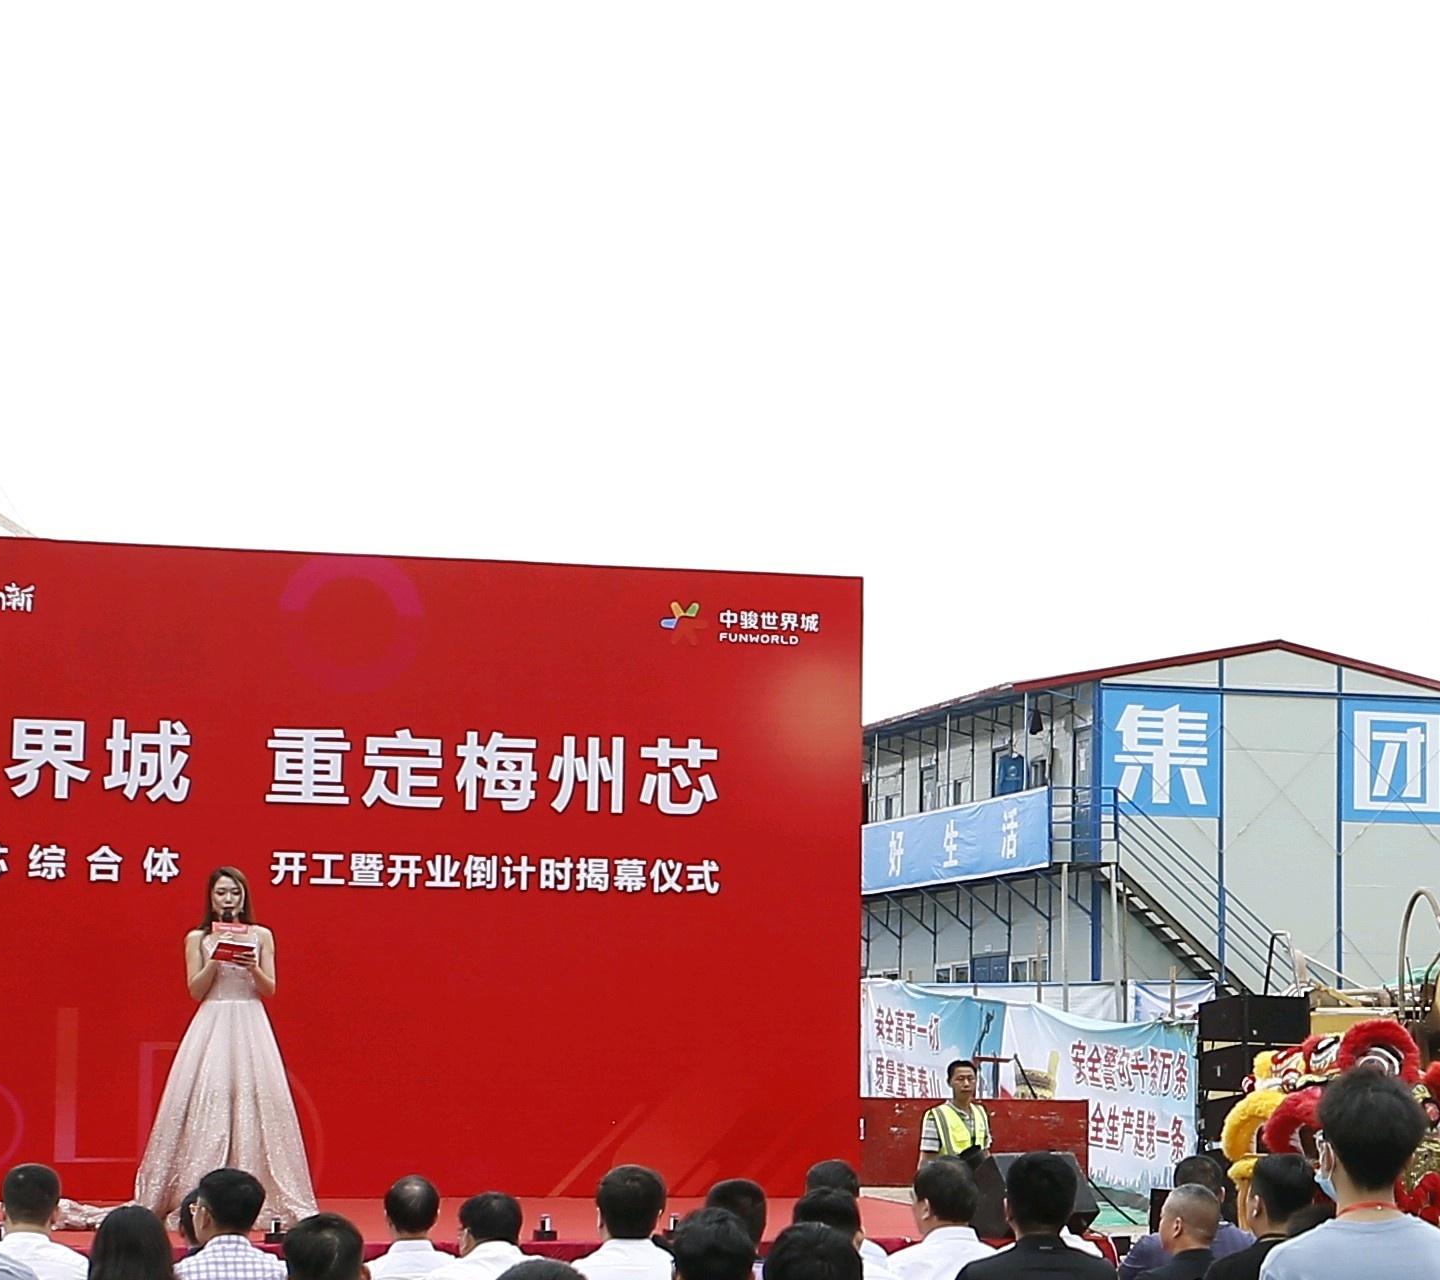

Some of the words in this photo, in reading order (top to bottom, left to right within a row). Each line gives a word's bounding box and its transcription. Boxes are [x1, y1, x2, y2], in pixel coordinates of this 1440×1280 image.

[719, 610, 820, 632] 中骏世界城
[719, 632, 799, 645] FUNWORLD
[264, 727, 720, 816] 重定梅州芯
[270, 850, 721, 894] 开工暨开业倒计时揭幕仪式
